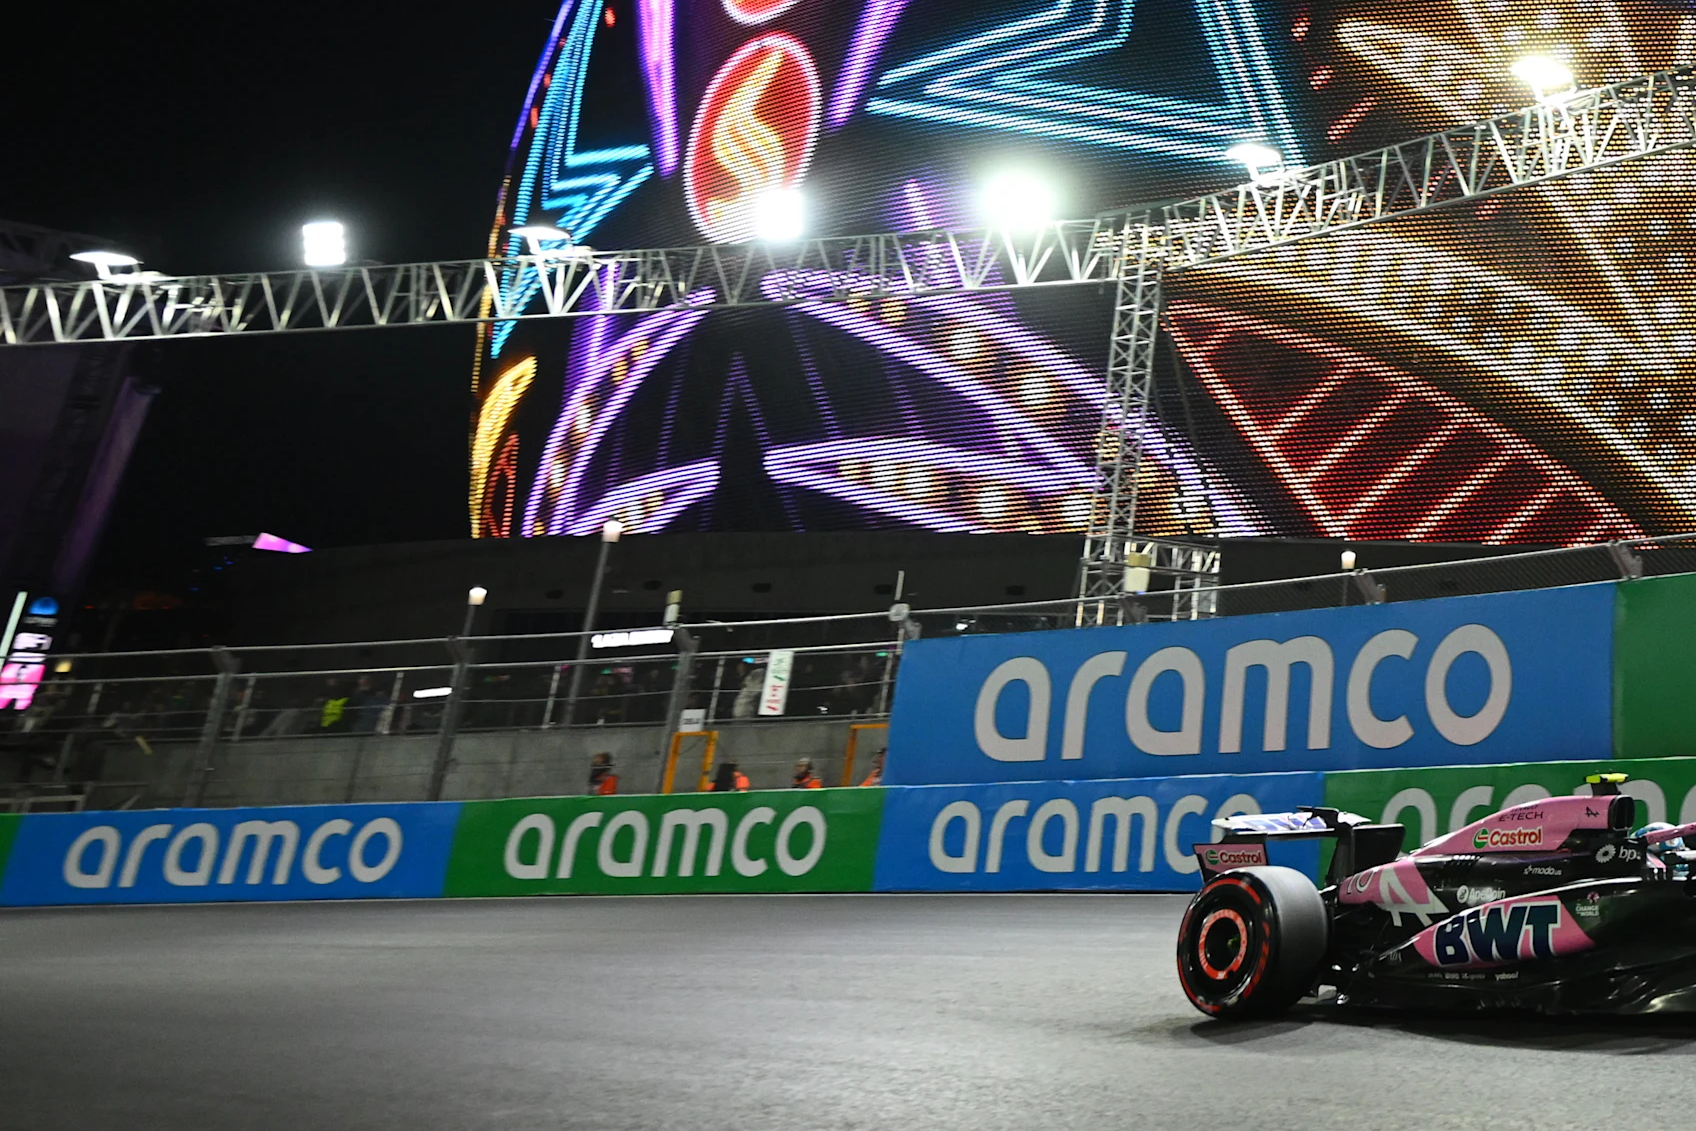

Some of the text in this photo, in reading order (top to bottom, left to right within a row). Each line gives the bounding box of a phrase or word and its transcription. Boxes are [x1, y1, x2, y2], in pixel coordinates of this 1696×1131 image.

[974, 624, 1512, 762] aramco
[503, 805, 826, 880] aramco
[1489, 827, 1542, 847] Castrol
[1498, 811, 1543, 822] E-TECH
[63, 817, 403, 889] aramco
[1219, 851, 1262, 864] Castrol
[1433, 901, 1561, 967] BWT
